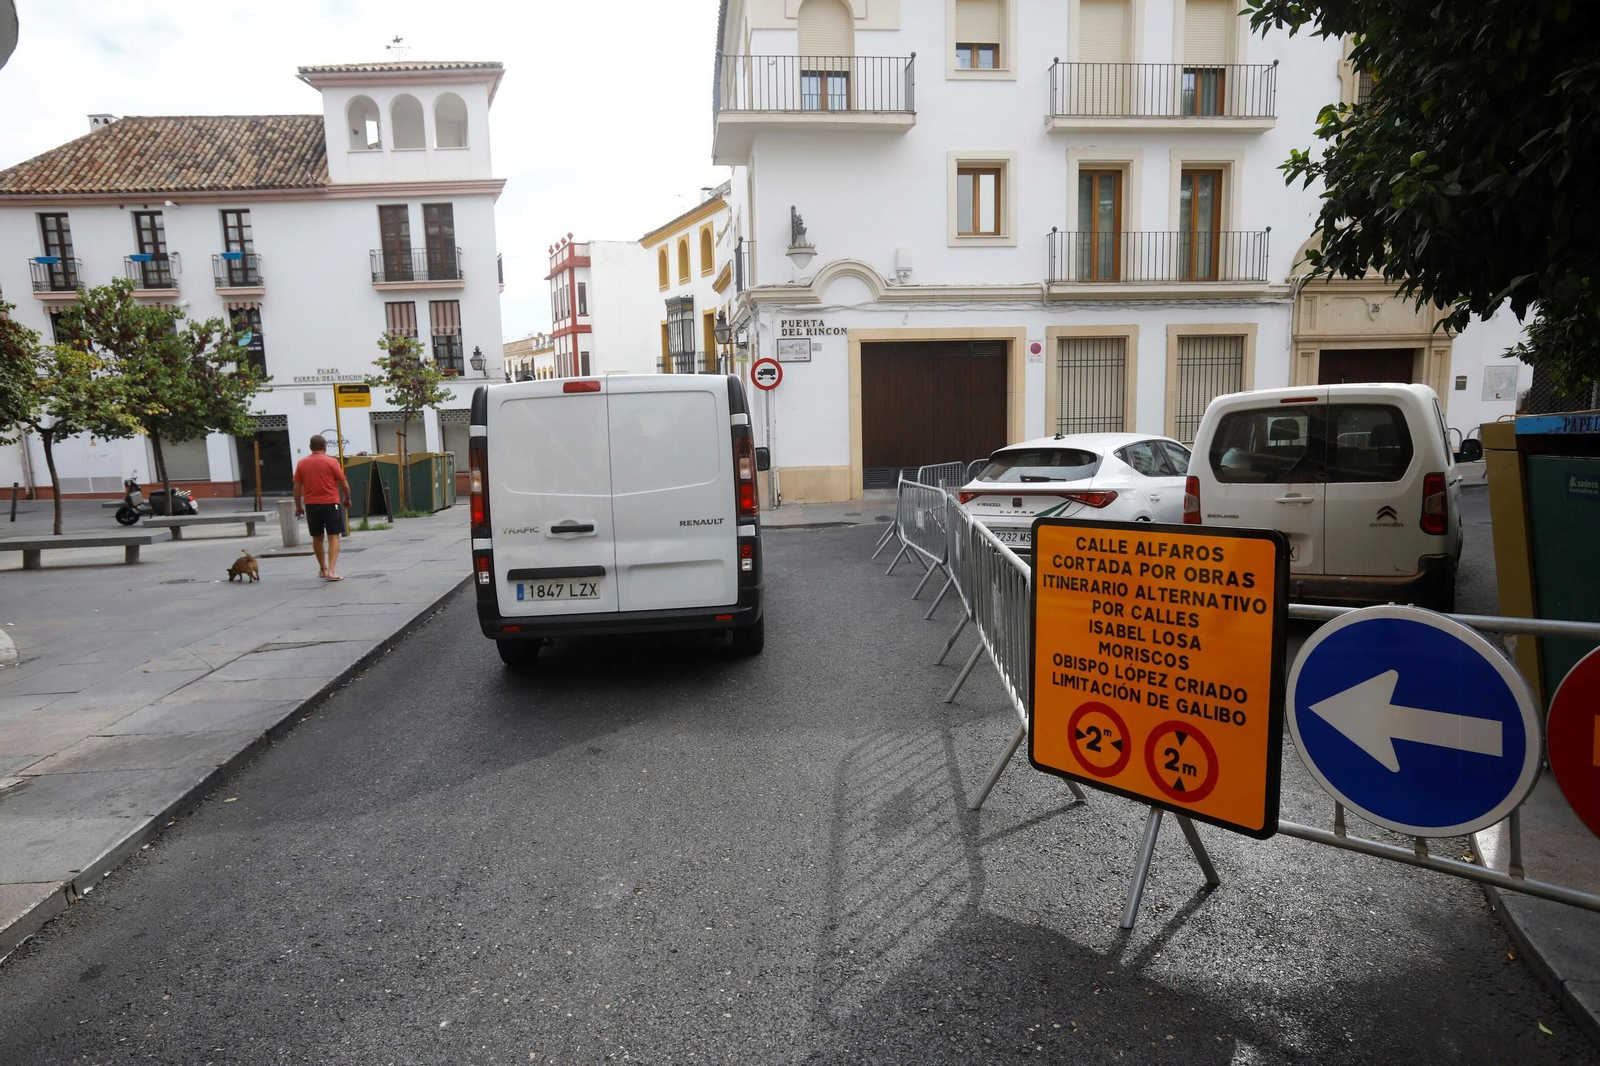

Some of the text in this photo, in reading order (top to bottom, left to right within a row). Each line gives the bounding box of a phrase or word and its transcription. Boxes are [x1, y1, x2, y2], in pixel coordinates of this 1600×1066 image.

[1371, 303, 1380, 313] 26
[781, 319, 825, 328] PUERTA
[781, 327, 848, 336] DEL RINCON
[337, 374, 364, 382] RINCON
[1577, 479, 1599, 489] sadeco
[679, 517, 724, 527] RENAULT
[501, 526, 540, 535] TRAFIC
[995, 532, 1032, 543] 7232 MS
[1076, 536, 1225, 563] CALLE ALFAROS
[1052, 554, 1256, 588] CORTADA POR OBRAS
[529, 582, 597, 598] 1847 LZX
[1042, 573, 1268, 615] ITINERARIO ALTERNATIVO
[1092, 600, 1200, 629] POR CALLES
[1088, 619, 1202, 651] ISABEL LOSA
[1098, 641, 1190, 671] MORISCOS
[1052, 652, 1248, 705] OBISPO LÓPEZ CRIADO
[1052, 671, 1247, 727] LIMITACIÓN DE GALIBO
